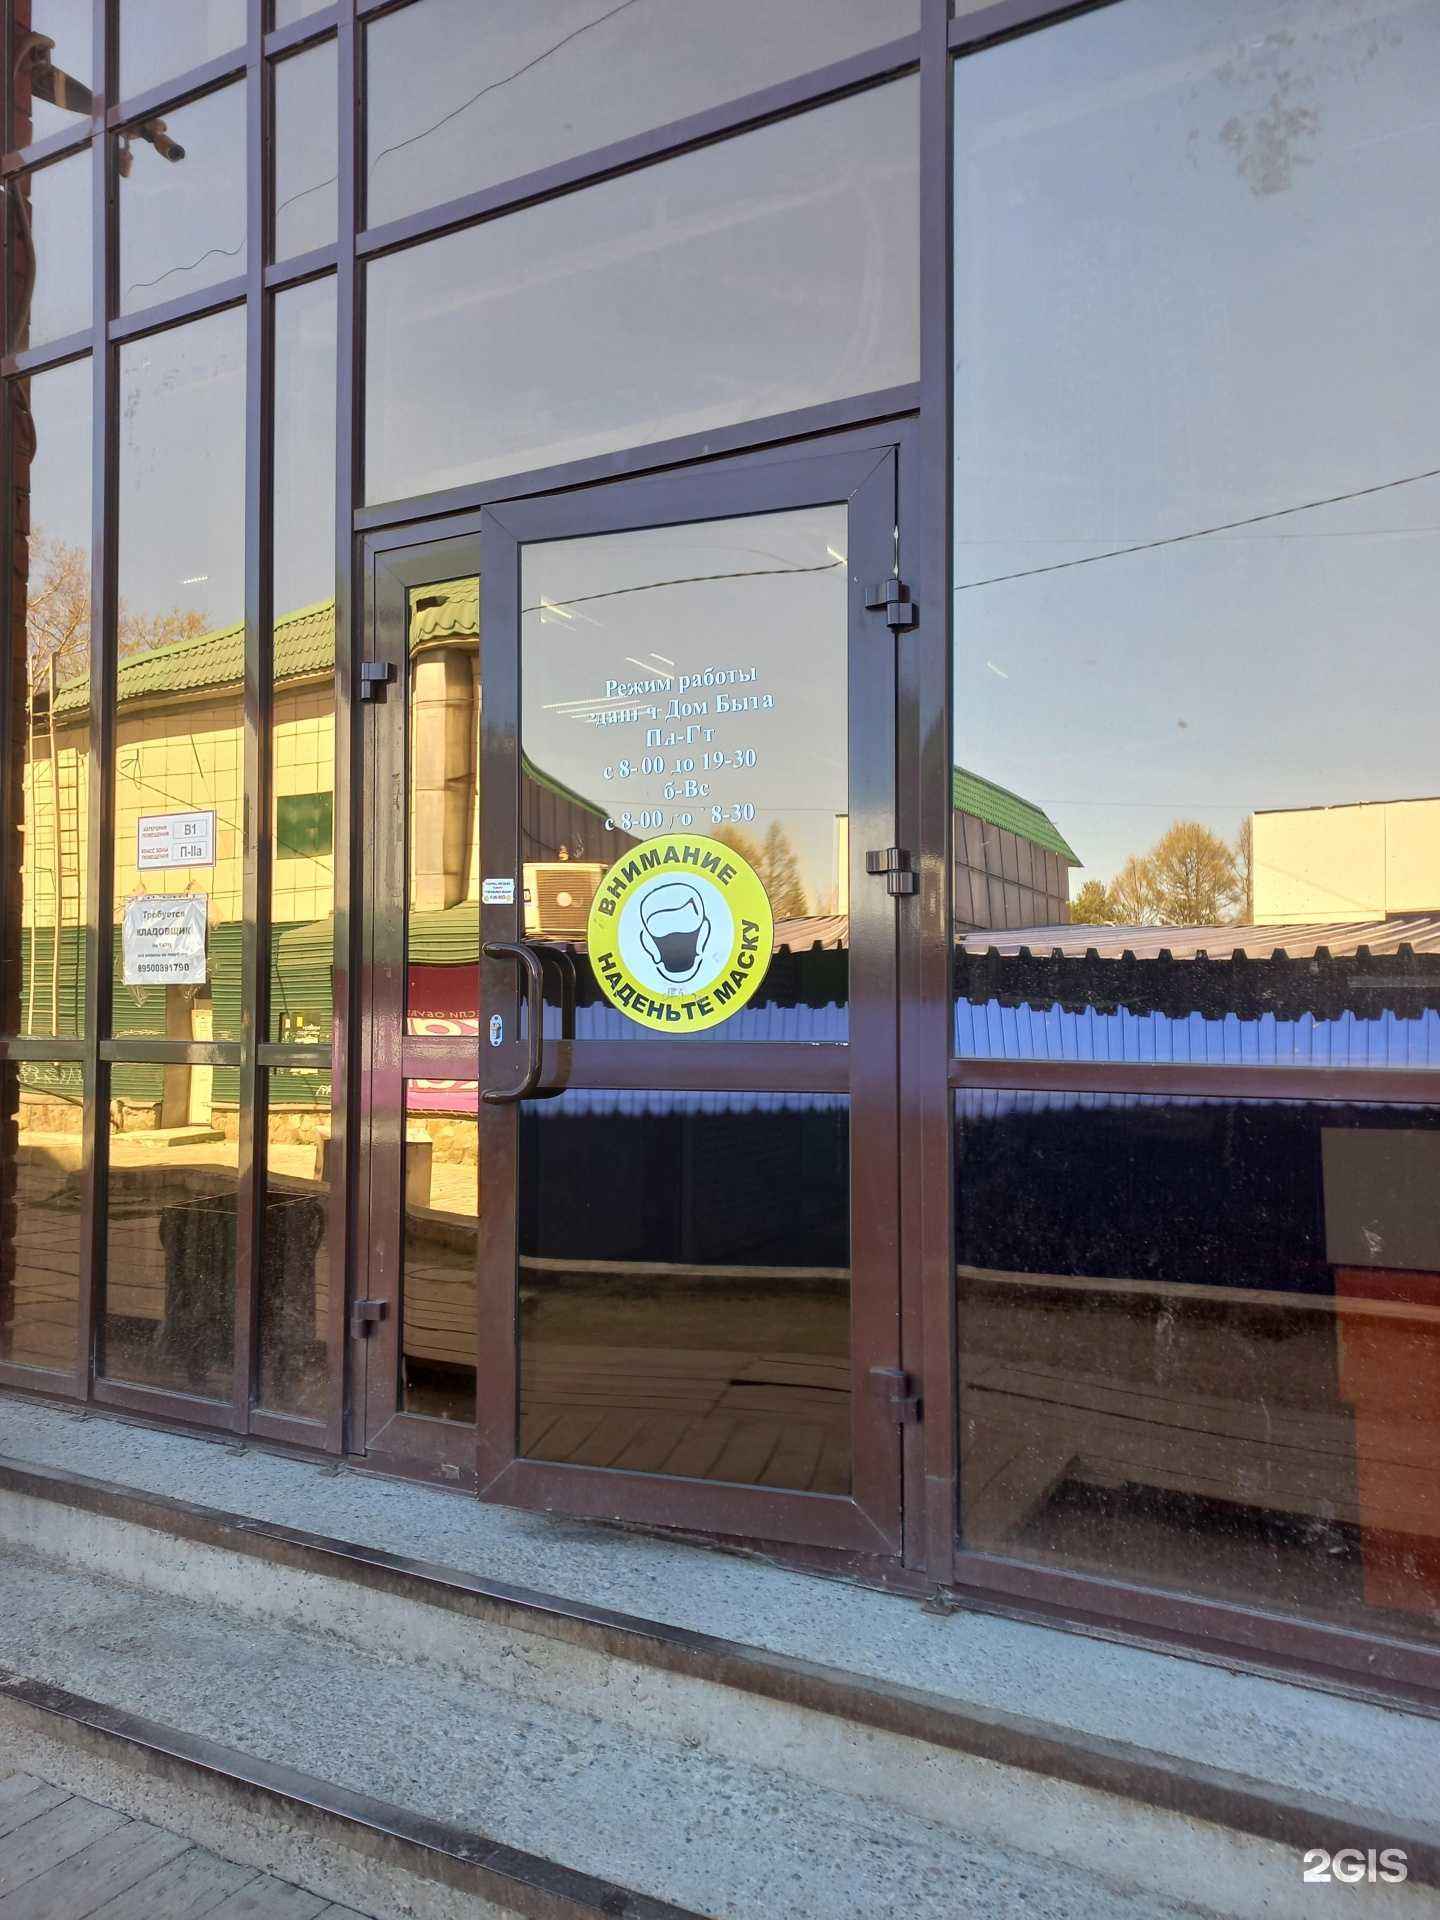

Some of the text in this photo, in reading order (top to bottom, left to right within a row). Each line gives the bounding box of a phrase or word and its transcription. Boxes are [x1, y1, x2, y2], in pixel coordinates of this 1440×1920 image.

[605, 665, 757, 698] Режим работы
[665, 698, 708, 721] Дом
[603, 765, 614, 780] с
[702, 748, 758, 771] 19-30
[604, 816, 616, 831] с
[620, 809, 664, 831] 8-00
[598, 845, 738, 917] ВНИМАНИЕ
[597, 918, 760, 1022] НАДЕНЬТЕ МАСКУ
